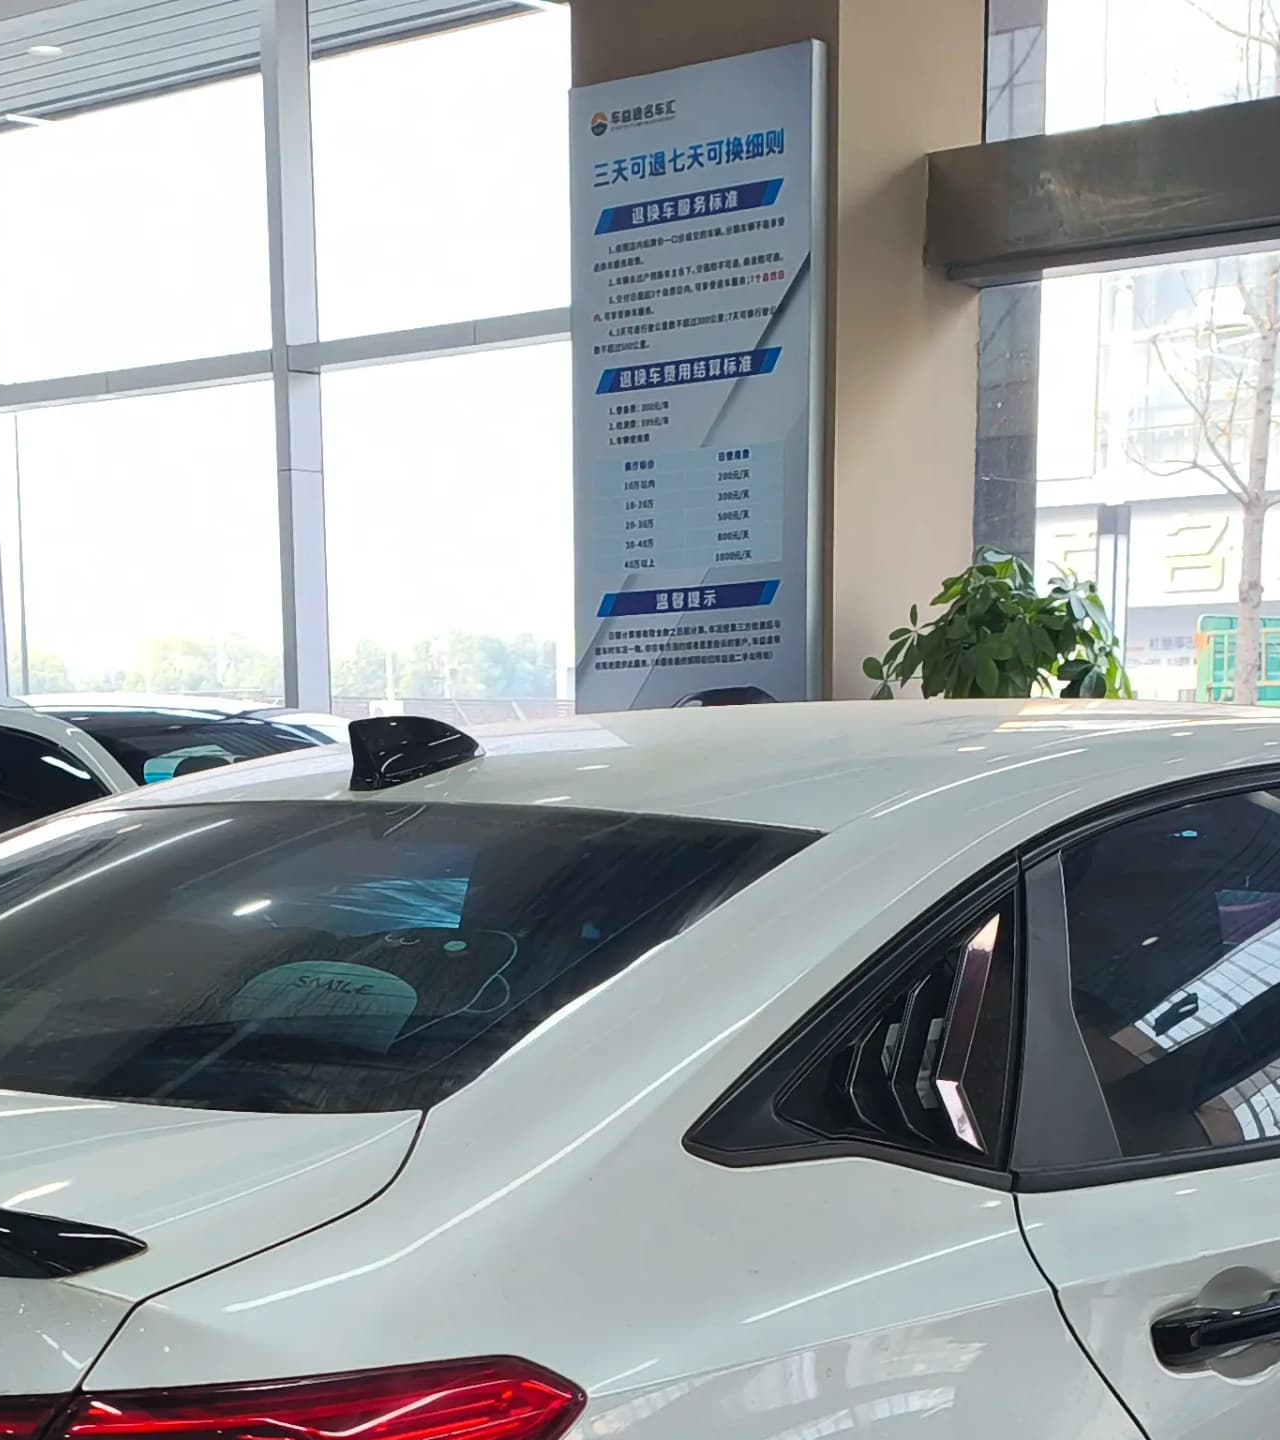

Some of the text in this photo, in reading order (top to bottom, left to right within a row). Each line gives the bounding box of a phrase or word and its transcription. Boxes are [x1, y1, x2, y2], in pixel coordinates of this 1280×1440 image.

[593, 128, 785, 187] 三天可退七天可换细则
[631, 190, 739, 225] 退换车服务标准
[619, 355, 753, 388] 退换车费用结算标准
[655, 589, 718, 610] 温馨提示
[296, 975, 375, 994] SMILE
